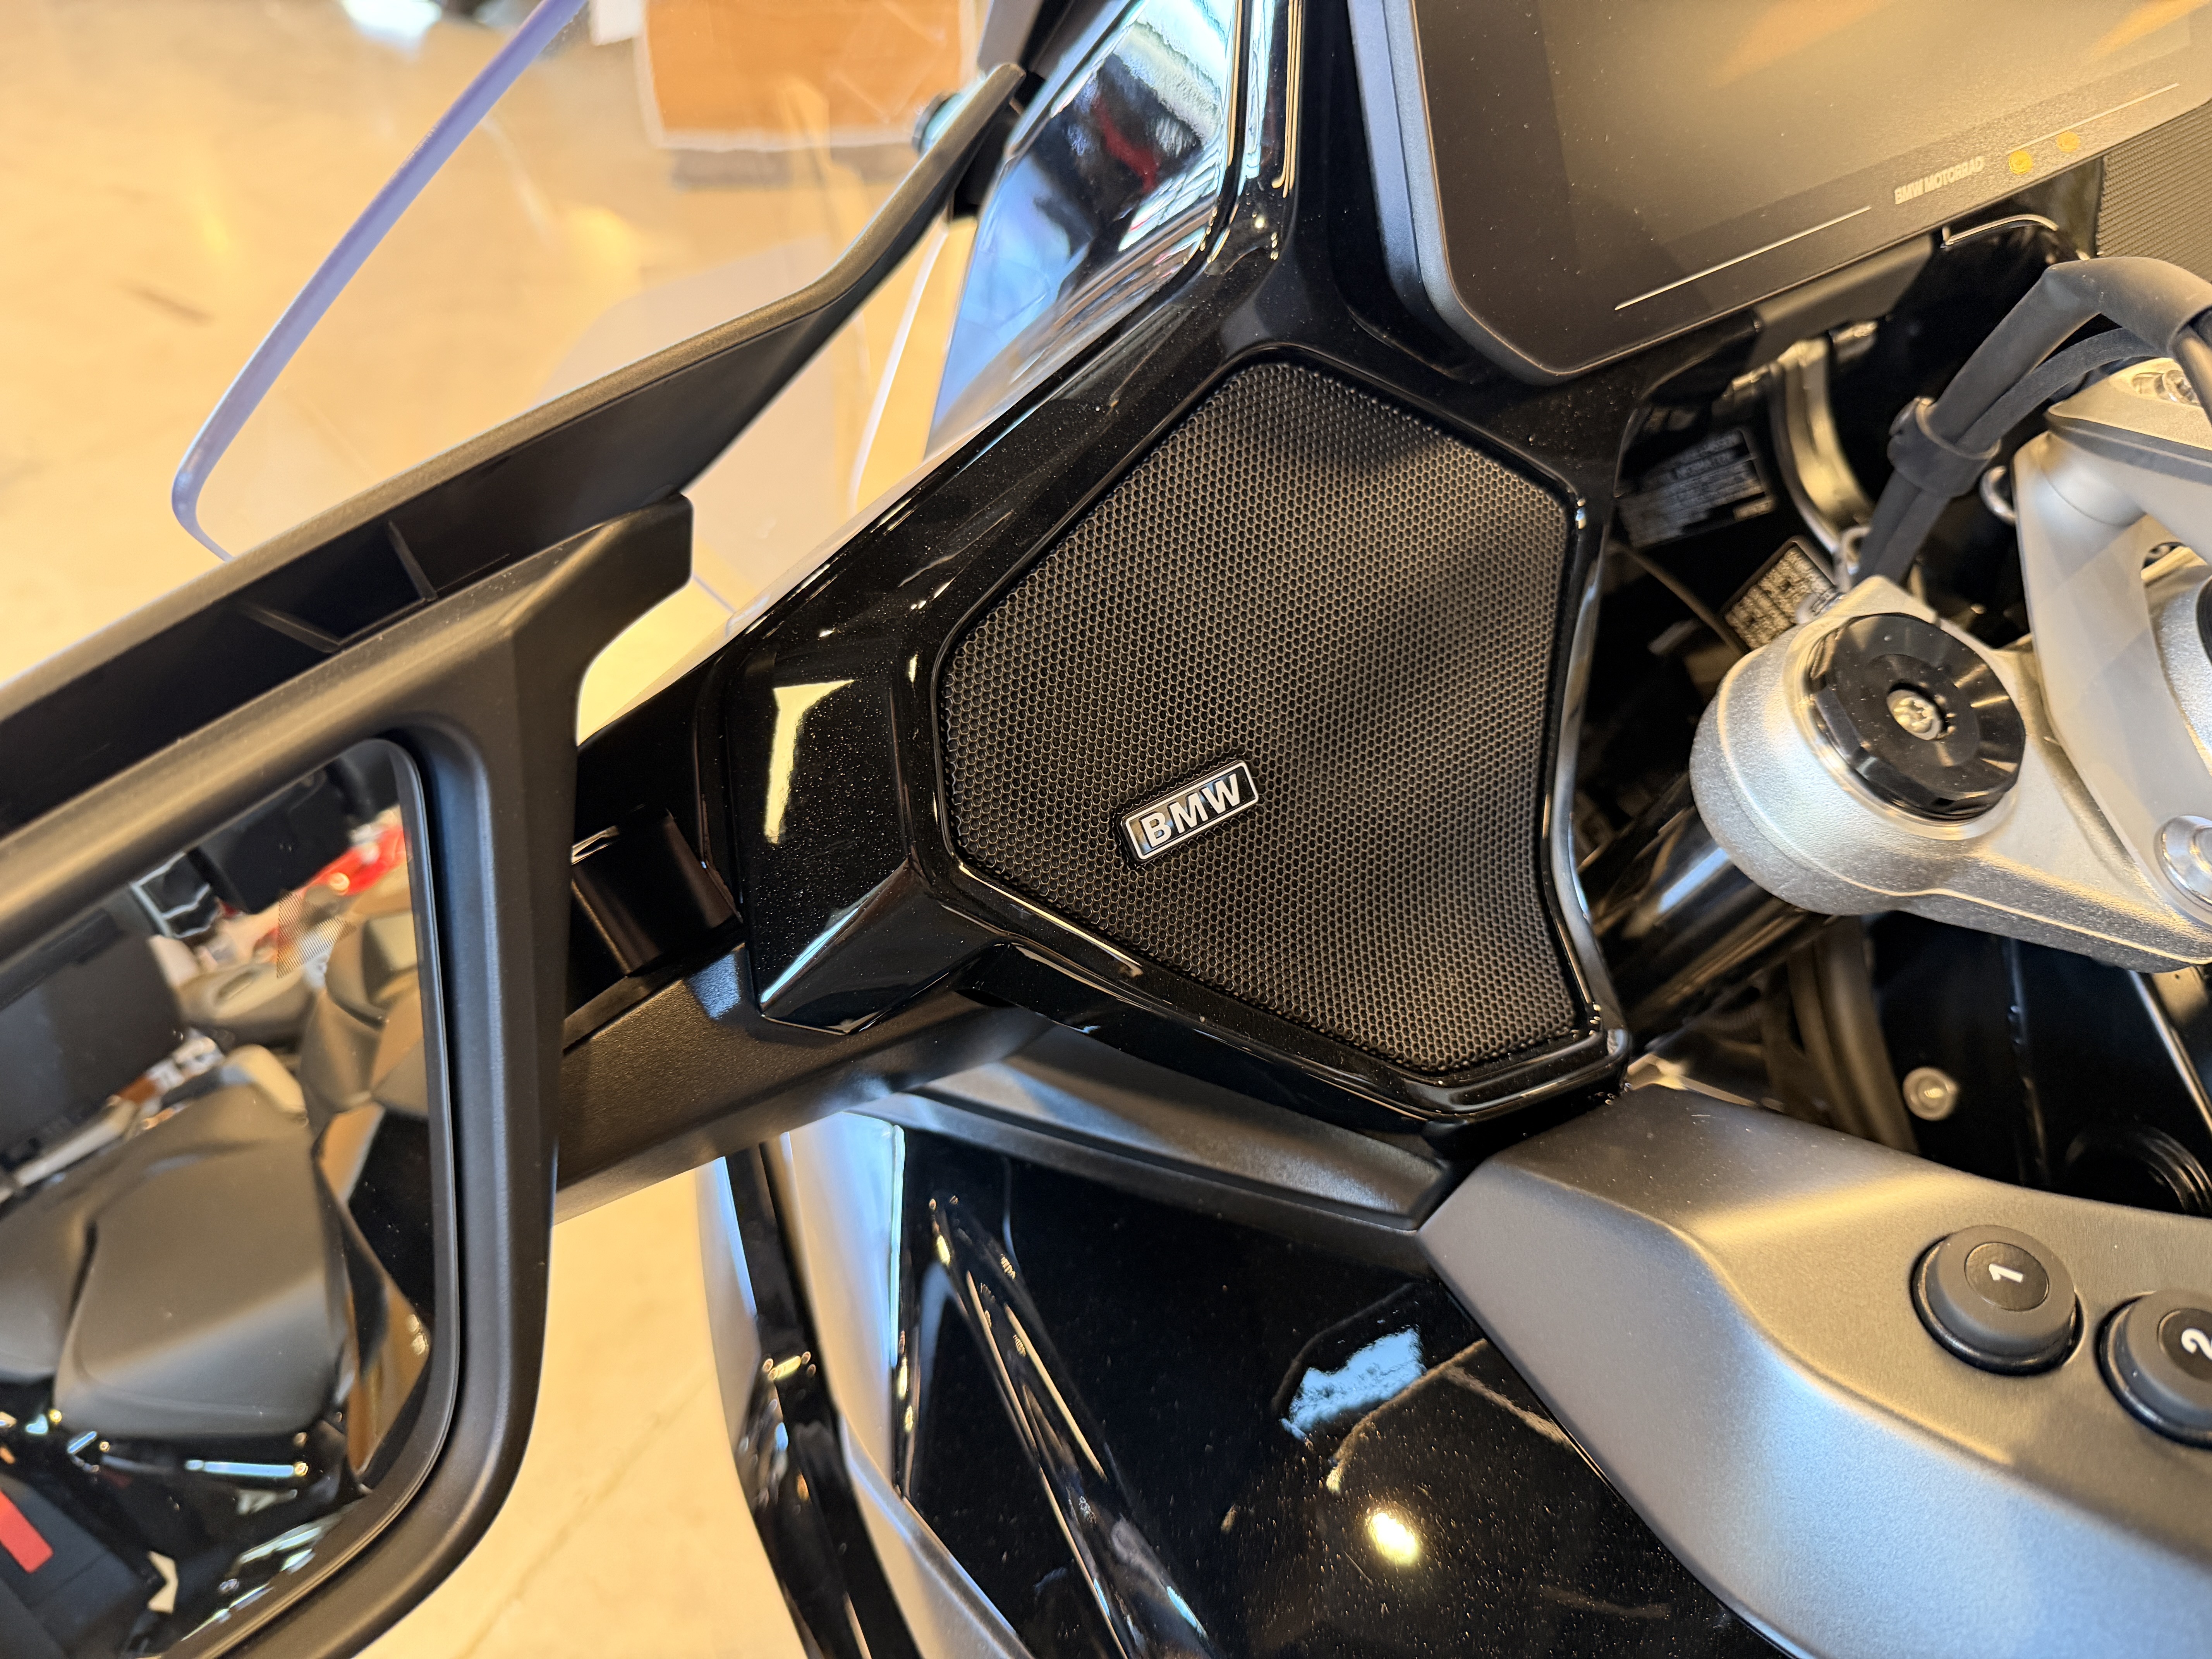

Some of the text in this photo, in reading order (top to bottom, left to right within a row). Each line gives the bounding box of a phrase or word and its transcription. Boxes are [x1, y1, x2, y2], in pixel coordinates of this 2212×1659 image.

[1894, 156, 1985, 204] BMW MOTORRAD
[1141, 773, 1240, 848] BMW
[1989, 1264, 2023, 1283] 1
[2181, 1328, 2212, 1360] 2
